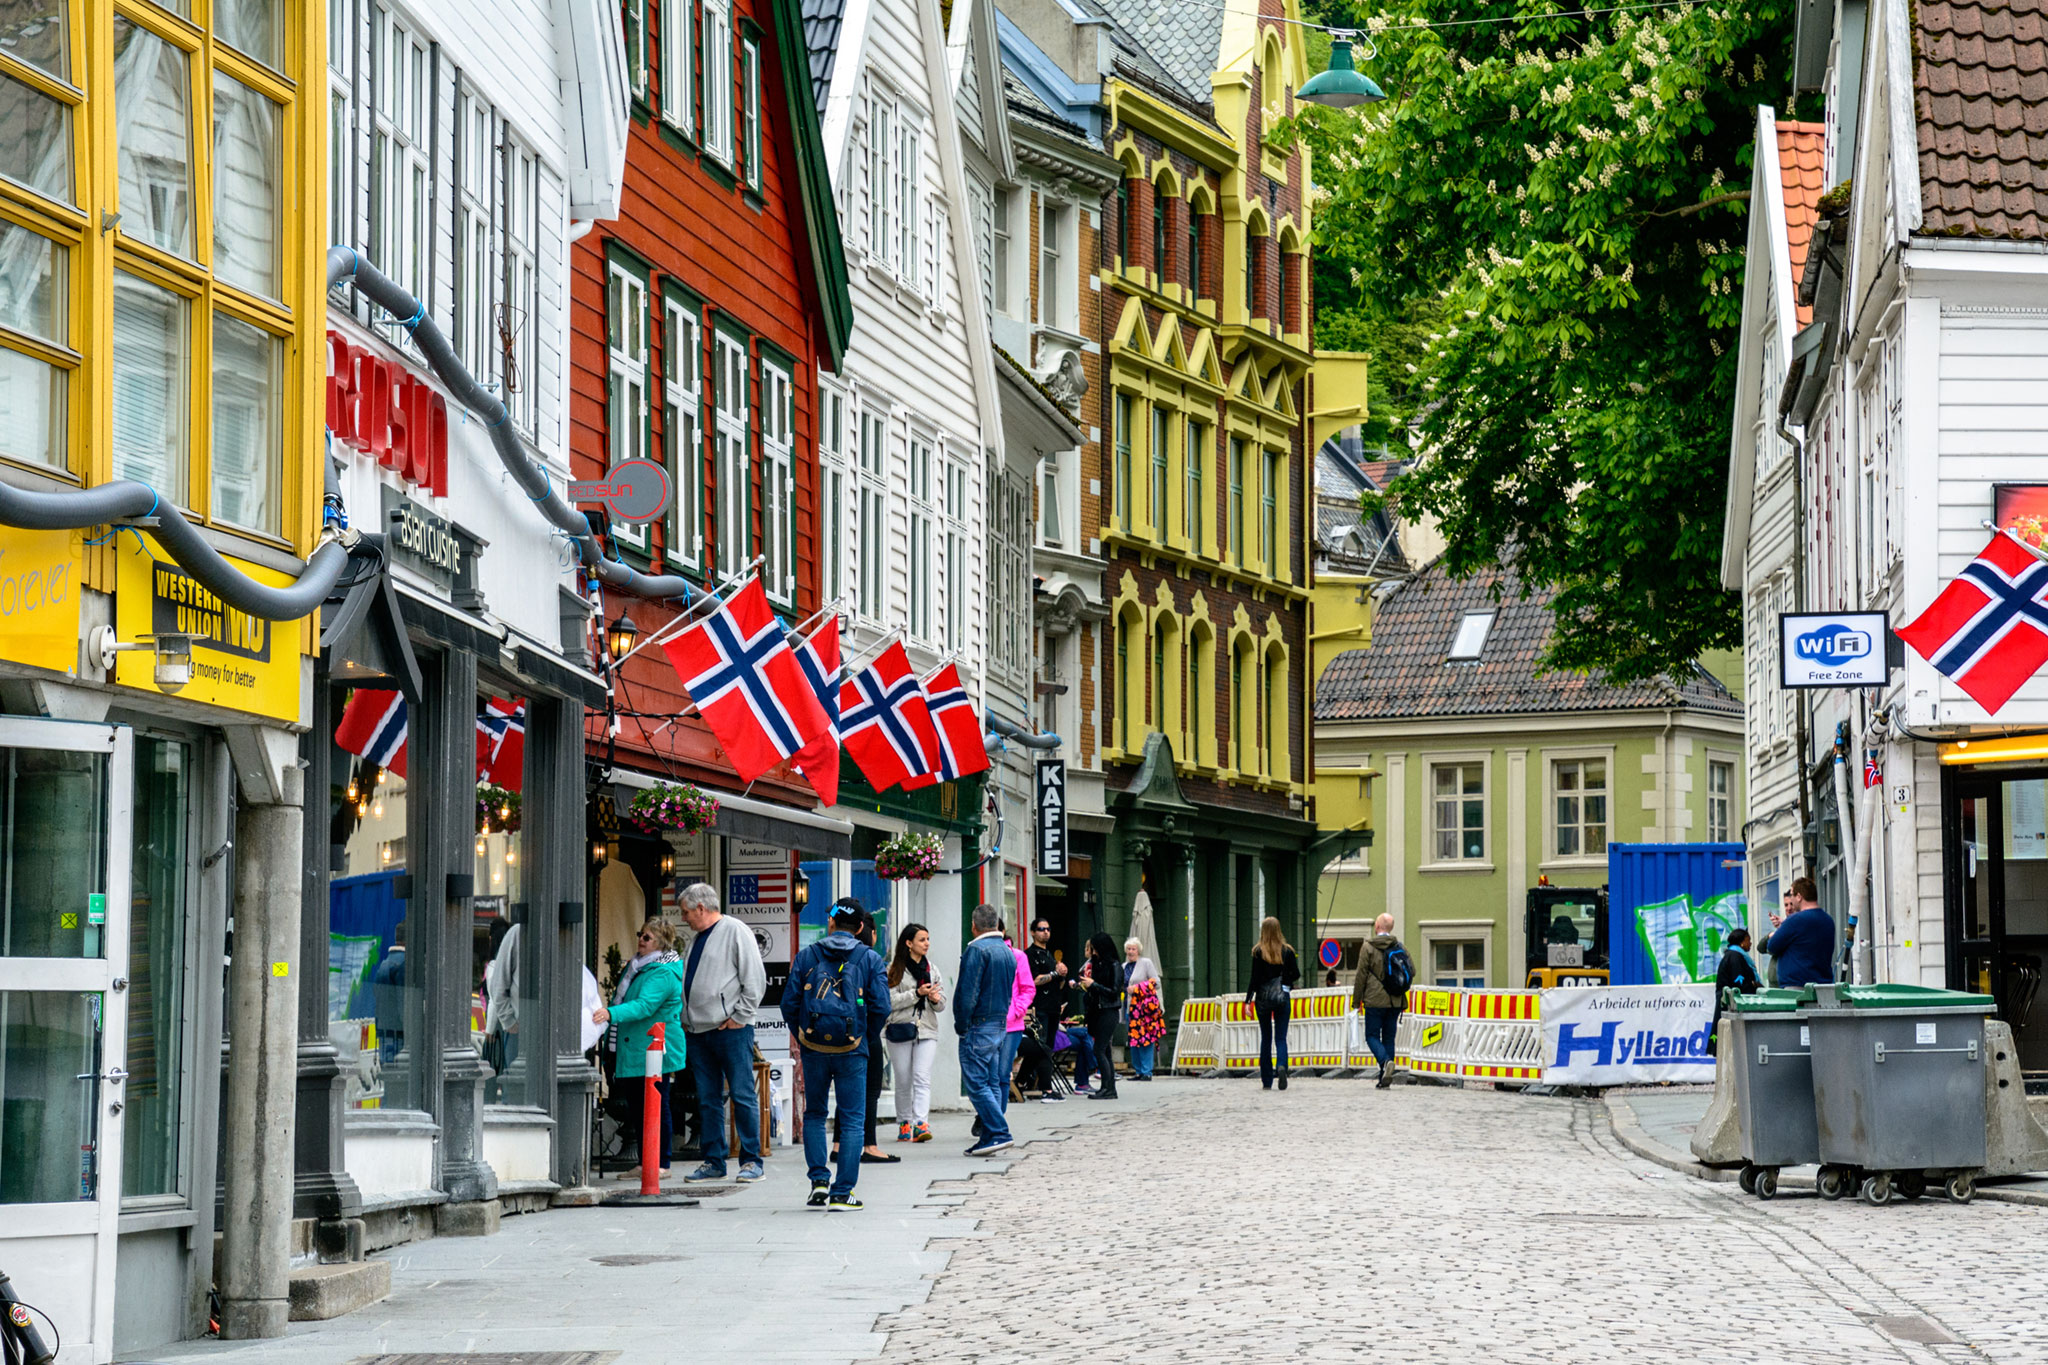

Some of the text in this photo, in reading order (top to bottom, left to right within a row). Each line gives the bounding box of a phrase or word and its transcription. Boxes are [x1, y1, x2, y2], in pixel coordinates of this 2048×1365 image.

[400, 503, 461, 575] asian cuisine
[0, 552, 72, 616] orever
[156, 569, 222, 613] WESTERN
[177, 604, 222, 642] UNION
[197, 663, 222, 685] money
[223, 664, 234, 684] for
[234, 667, 256, 688] better
[1808, 670, 1863, 680] Free Zone
[1898, 788, 1905, 801] 3
[1042, 765, 1062, 870] KAFFE
[739, 848, 778, 857] Madrasser
[731, 907, 785, 915] LEXINGTON
[1588, 997, 1641, 1010] Arbeidet
[1689, 1000, 1705, 1009] av
[1552, 1020, 1714, 1067] Hylland
